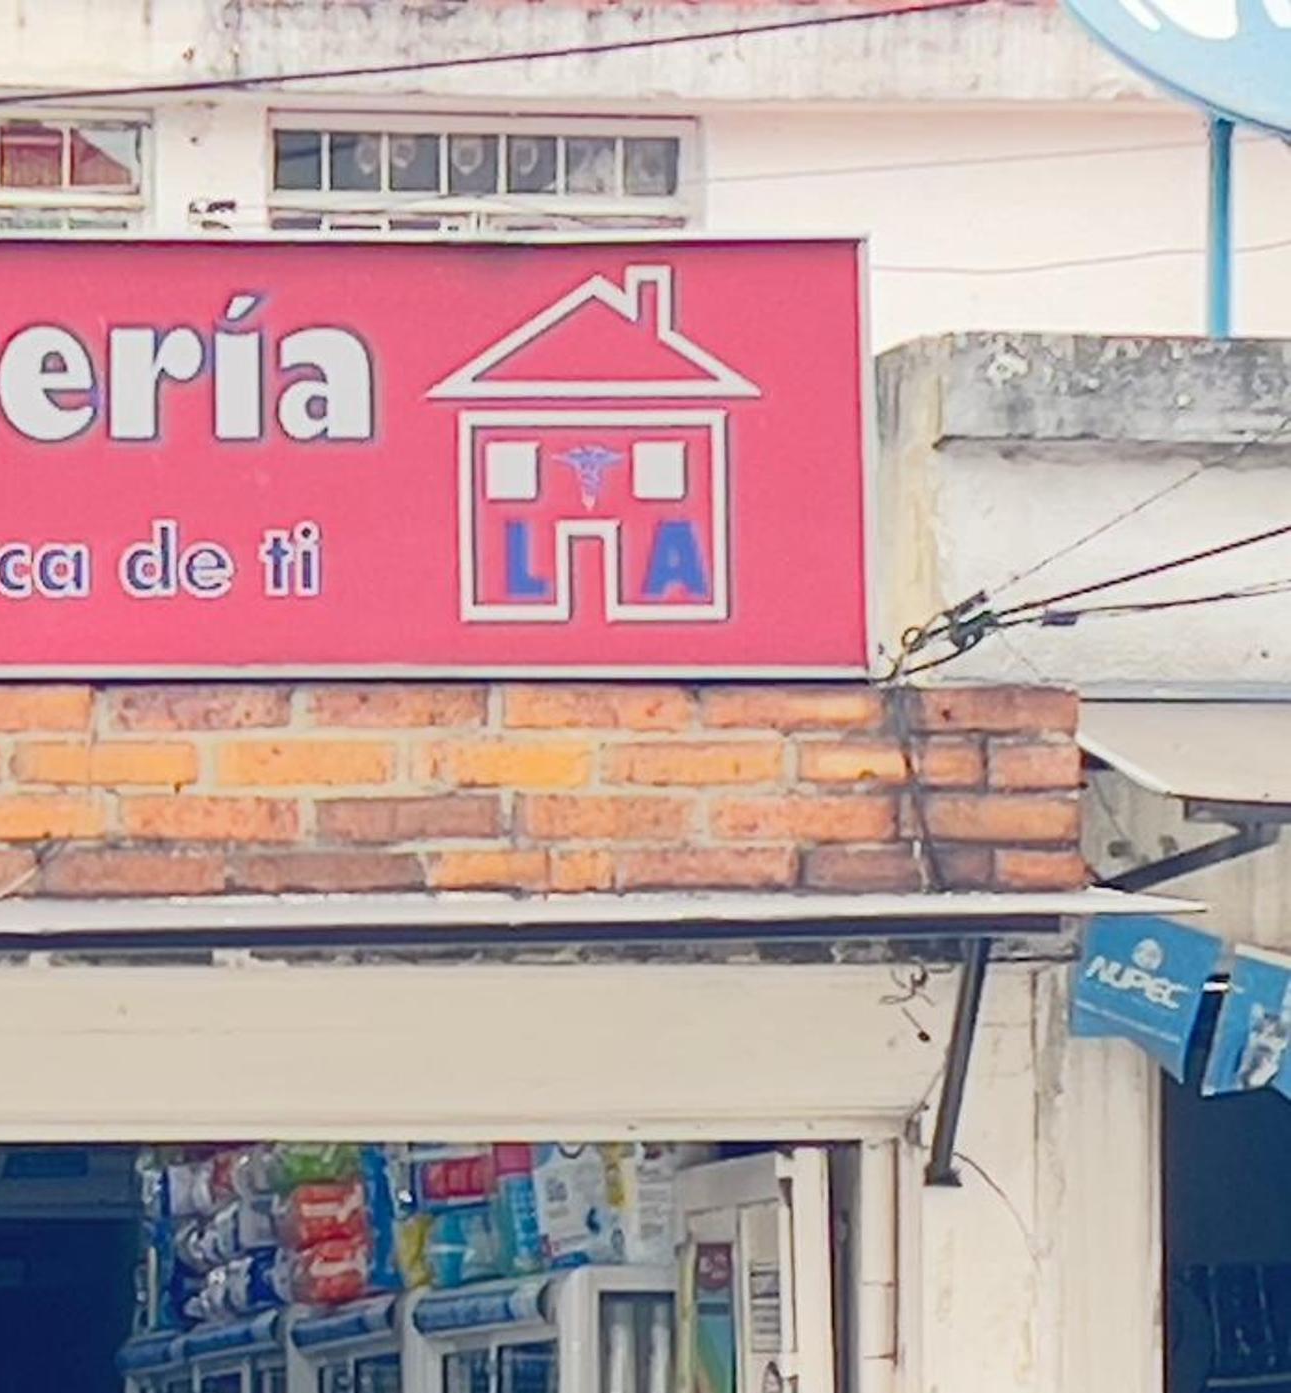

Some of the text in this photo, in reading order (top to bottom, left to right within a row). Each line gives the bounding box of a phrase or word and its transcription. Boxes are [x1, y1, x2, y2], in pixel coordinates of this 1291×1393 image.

[118, 518, 236, 599] de
[258, 520, 321, 597] ti
[1085, 955, 1190, 1011] NUPEC
